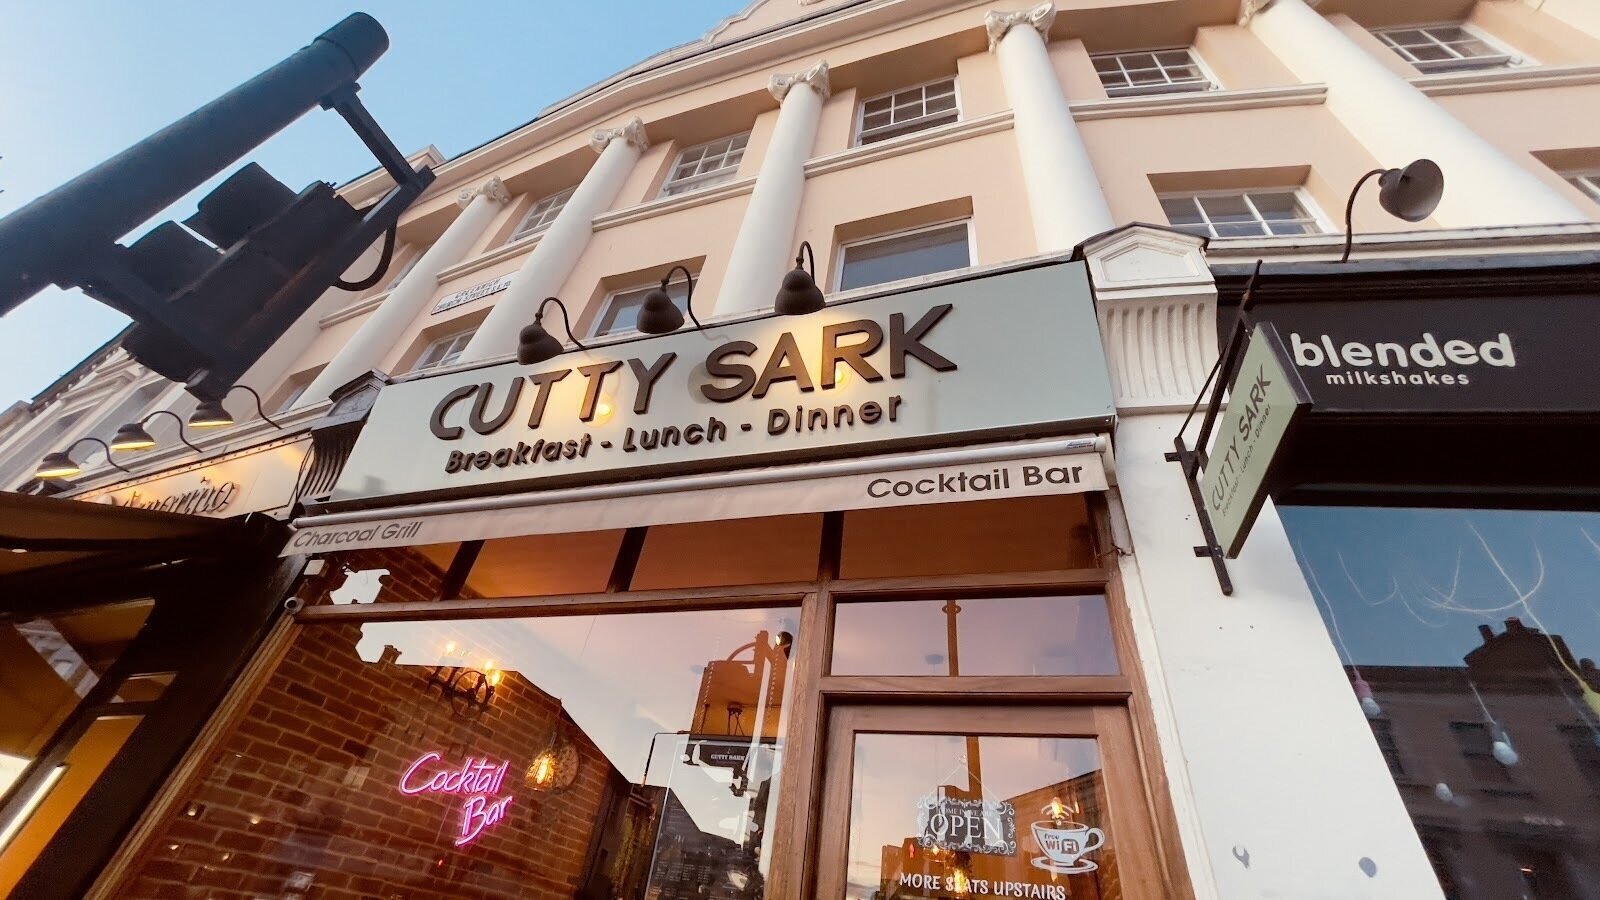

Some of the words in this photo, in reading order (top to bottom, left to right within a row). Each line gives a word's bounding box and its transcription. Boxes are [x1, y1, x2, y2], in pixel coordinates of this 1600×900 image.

[1290, 332, 1516, 368] blended
[429, 352, 677, 440] CUTTY
[700, 303, 957, 403] SARK
[1326, 370, 1470, 385] milkshakes
[445, 433, 592, 474] Breakfast
[623, 416, 727, 452] Lunch
[767, 395, 902, 435] Dinner
[1211, 434, 1241, 511] CUTTY
[1238, 363, 1272, 442] SARK
[1254, 403, 1272, 438] Dinner
[867, 468, 1010, 498] Cocktail
[1022, 466, 1083, 486] Bar
[293, 525, 381, 548] Charcoal
[381, 521, 423, 539] Grill
[399, 751, 510, 795] Cocktail
[454, 795, 513, 847] Bar
[930, 813, 1000, 839] OPEN
[900, 872, 940, 890] MORE
[993, 880, 1066, 900] UPSTAIRS
